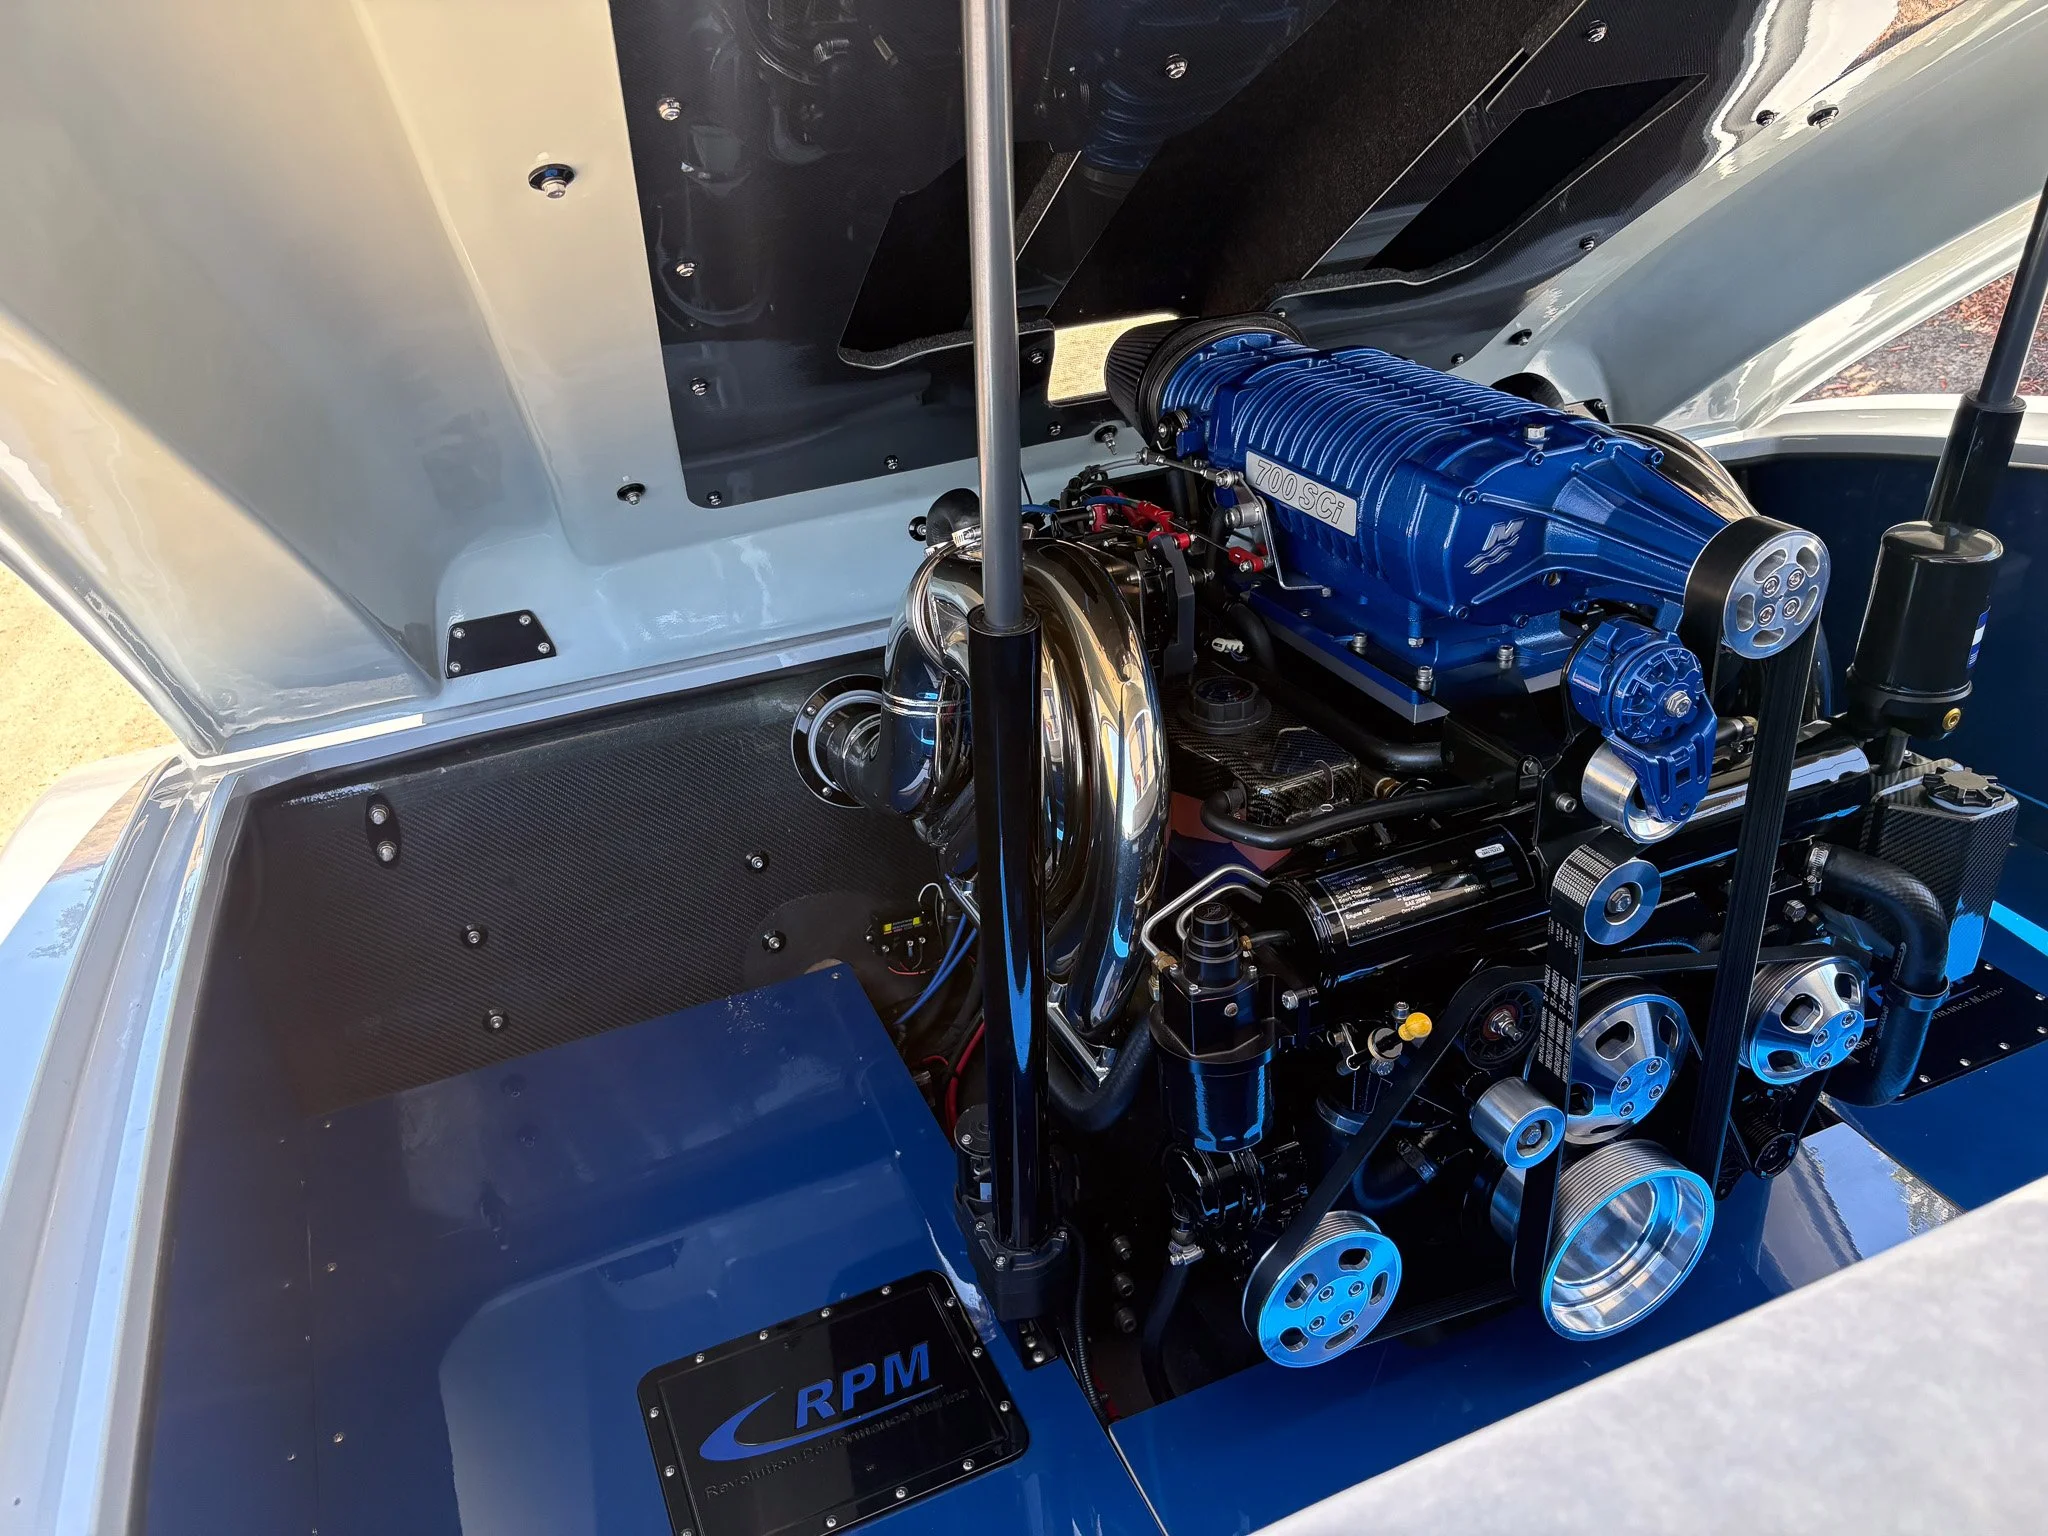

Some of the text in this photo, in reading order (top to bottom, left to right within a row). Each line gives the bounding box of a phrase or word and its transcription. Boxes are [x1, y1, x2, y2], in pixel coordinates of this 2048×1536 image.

[1255, 460, 1346, 525] 700 SCi
[1547, 1011, 1557, 1040] MARINE
[1556, 1018, 1565, 1047] MARINE
[1545, 1037, 1554, 1071] MERCURY
[1553, 1044, 1563, 1078] MERCURY
[796, 1341, 930, 1429] RPM
[704, 1453, 798, 1500] Revolution
